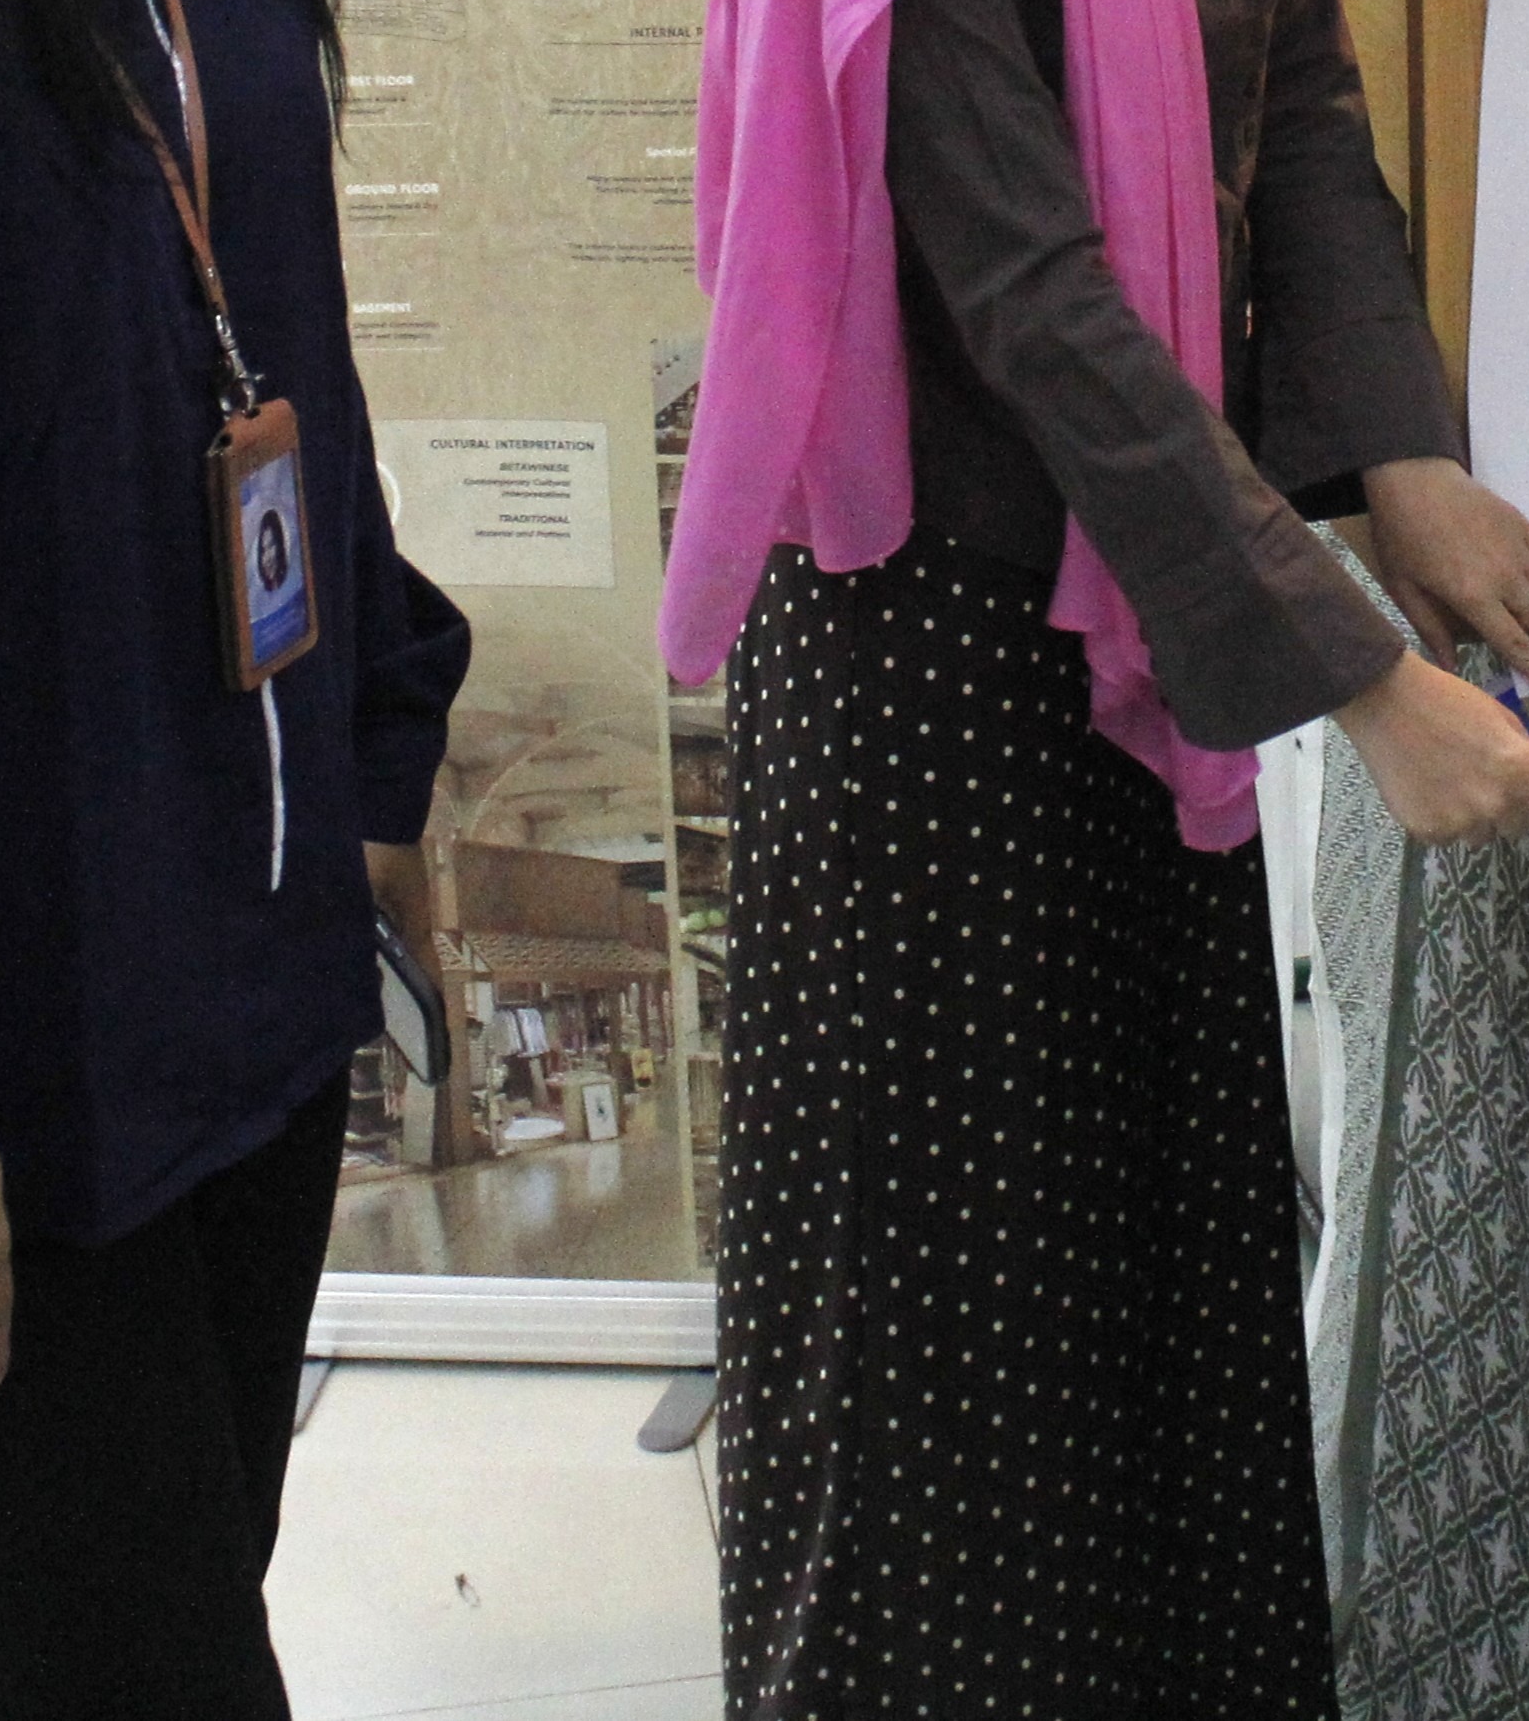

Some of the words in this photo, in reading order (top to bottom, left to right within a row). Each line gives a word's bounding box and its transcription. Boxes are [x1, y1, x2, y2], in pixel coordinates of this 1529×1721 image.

[630, 27, 691, 39] INTERNAL
[375, 75, 414, 86] FLOOR
[400, 183, 439, 194] FLOOR
[430, 439, 491, 450] CULTURAL
[495, 439, 596, 451] INTERPRETATION
[499, 514, 571, 524] TRADITIONAL
